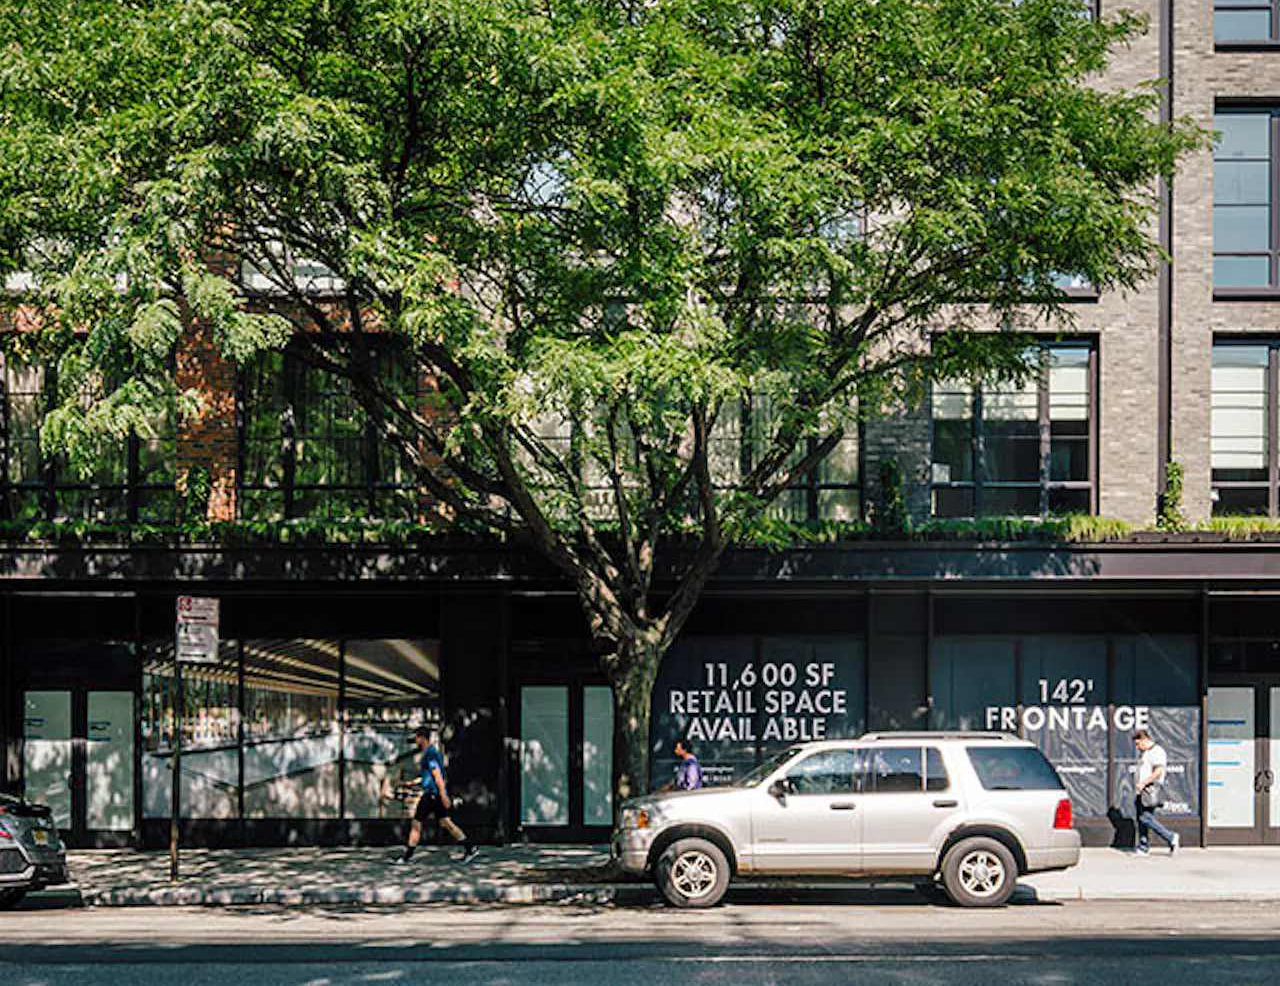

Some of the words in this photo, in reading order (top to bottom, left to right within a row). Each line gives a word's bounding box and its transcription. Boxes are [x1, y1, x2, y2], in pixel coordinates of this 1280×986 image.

[705, 663, 797, 691] 11,600
[805, 663, 835, 687] SF
[671, 690, 757, 714] RETAIL
[765, 690, 848, 714] SPACE
[1039, 679, 1094, 703] 142'
[686, 717, 827, 742] AVAILABLE
[986, 706, 1150, 731] FRONTAGE
